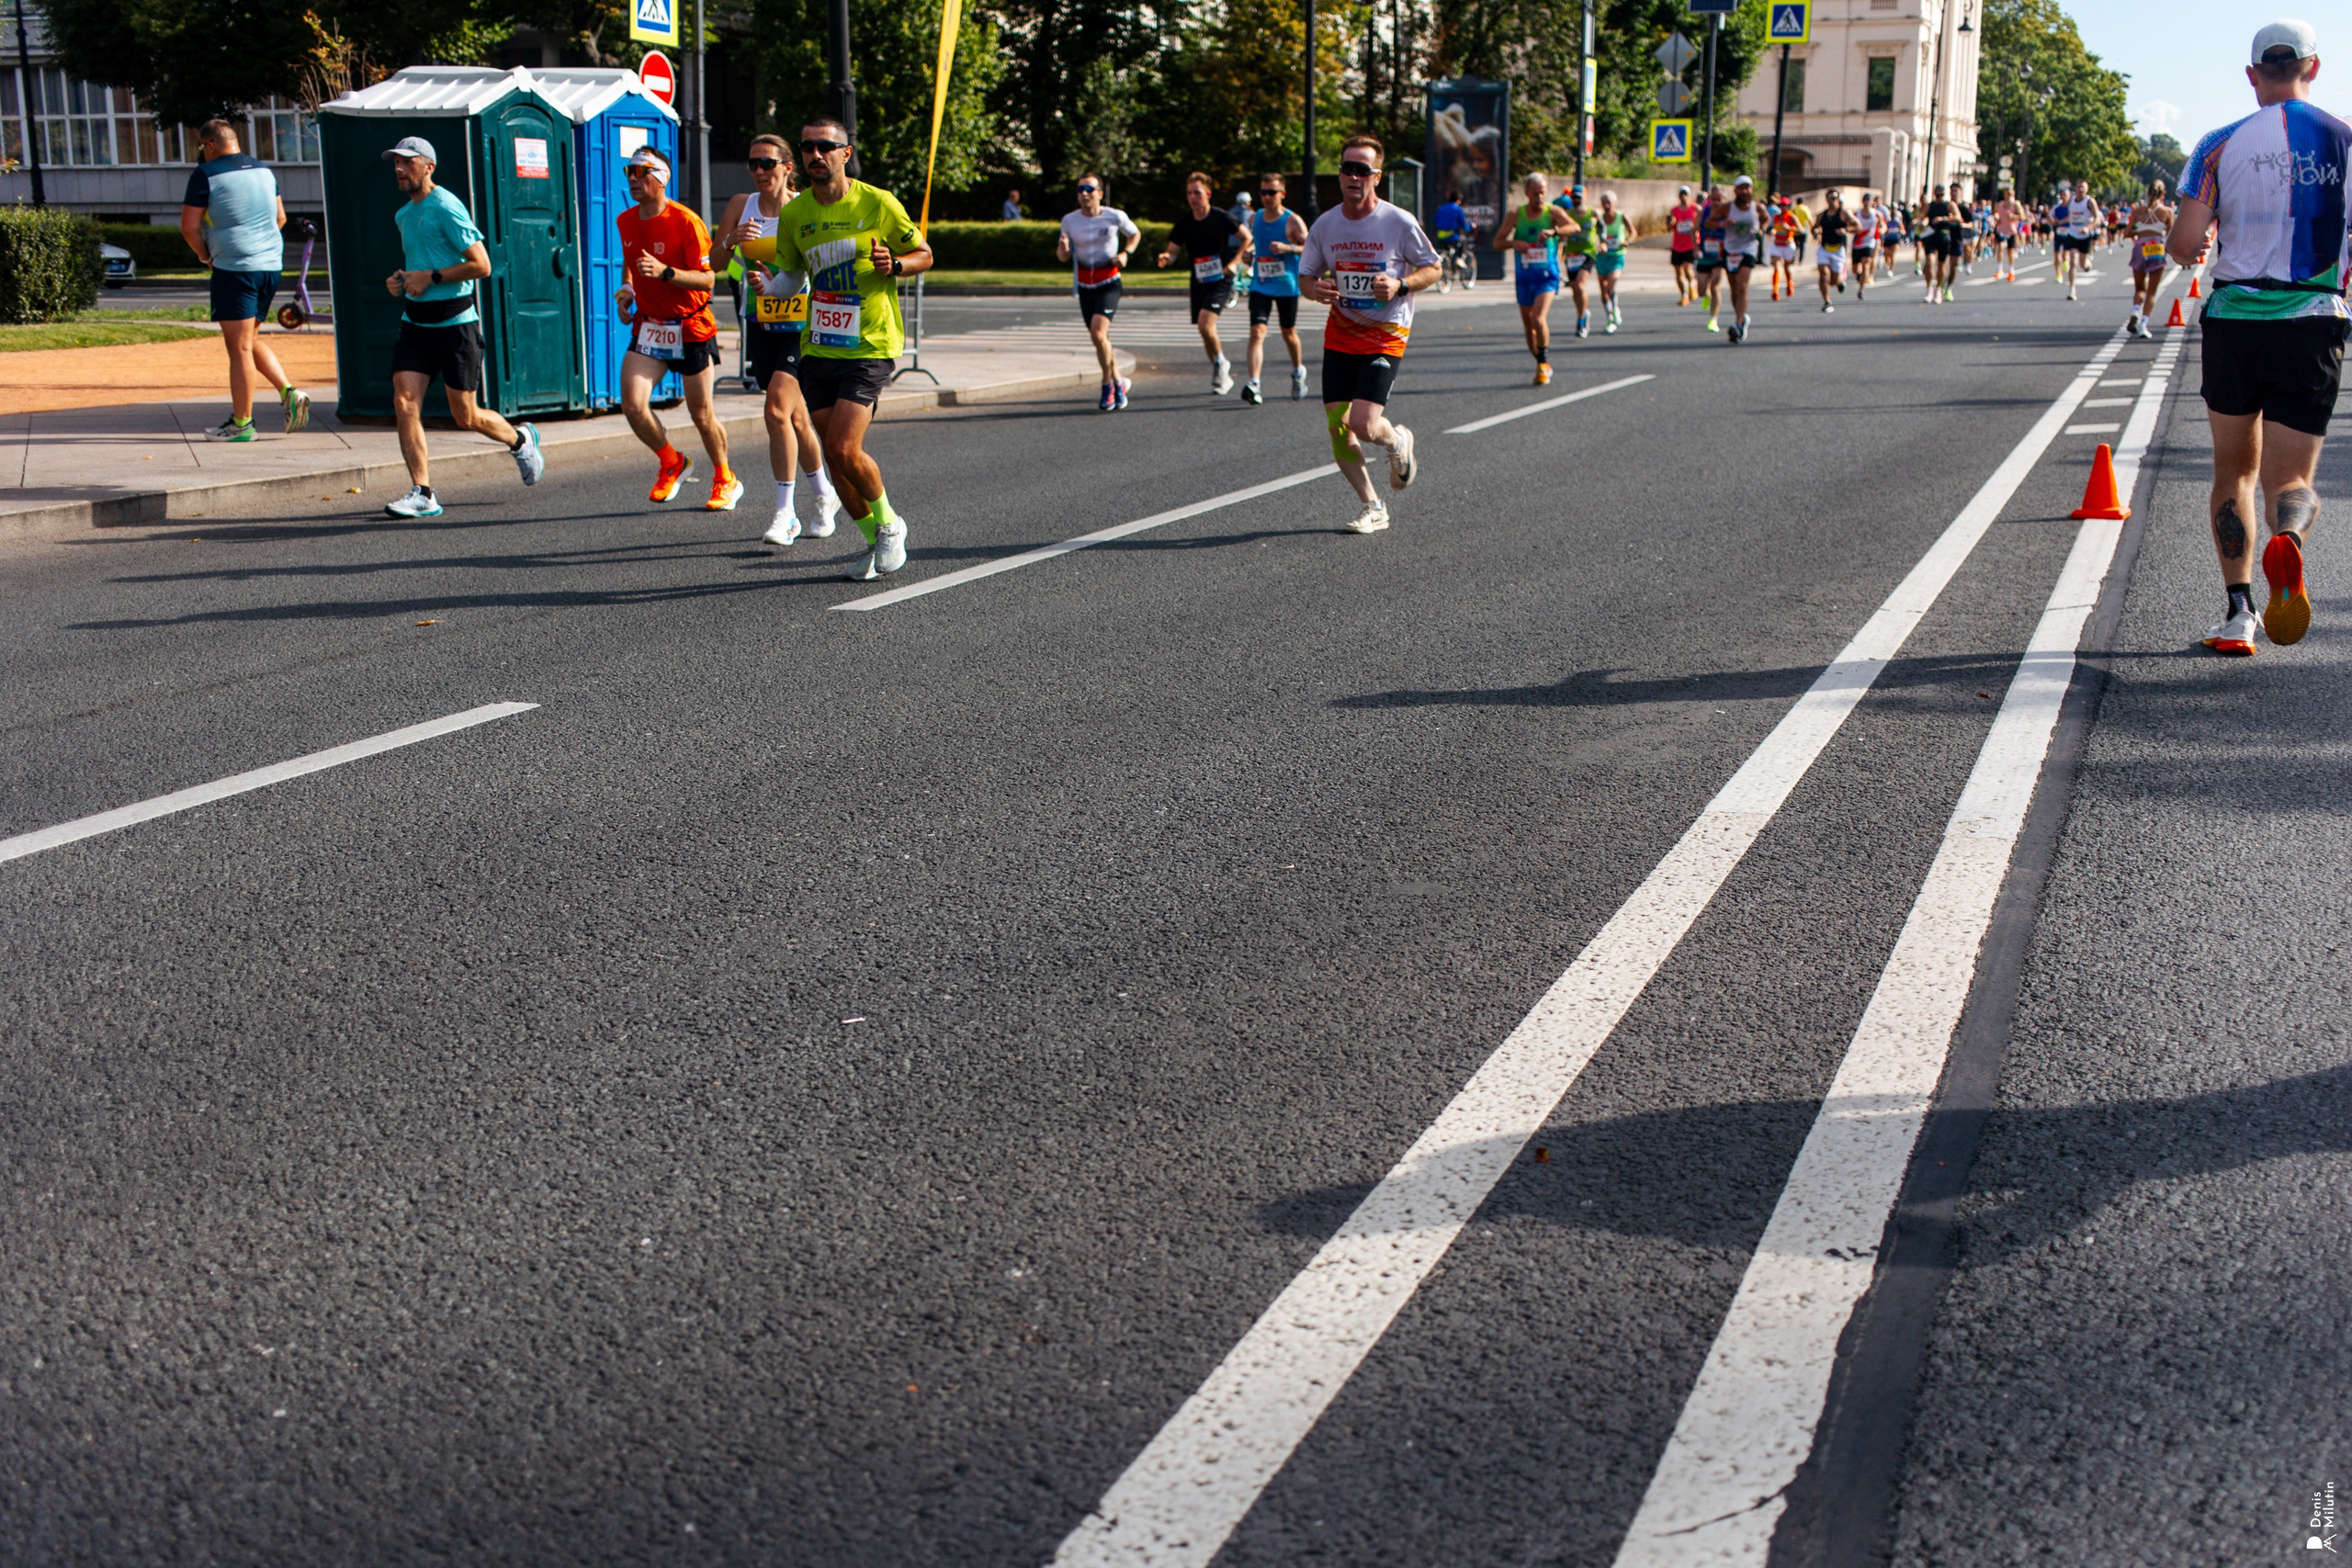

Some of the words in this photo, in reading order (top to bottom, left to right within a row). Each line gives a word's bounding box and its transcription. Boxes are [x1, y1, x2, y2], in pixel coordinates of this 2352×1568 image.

[653, 242, 665, 254] 10
[1330, 241, 1384, 252] УРАЛХИМ
[812, 258, 858, 291] МЕСТЕ
[763, 298, 802, 314] 5772
[816, 309, 853, 330] 7587
[646, 328, 676, 344] 7210
[813, 333, 819, 343] C
